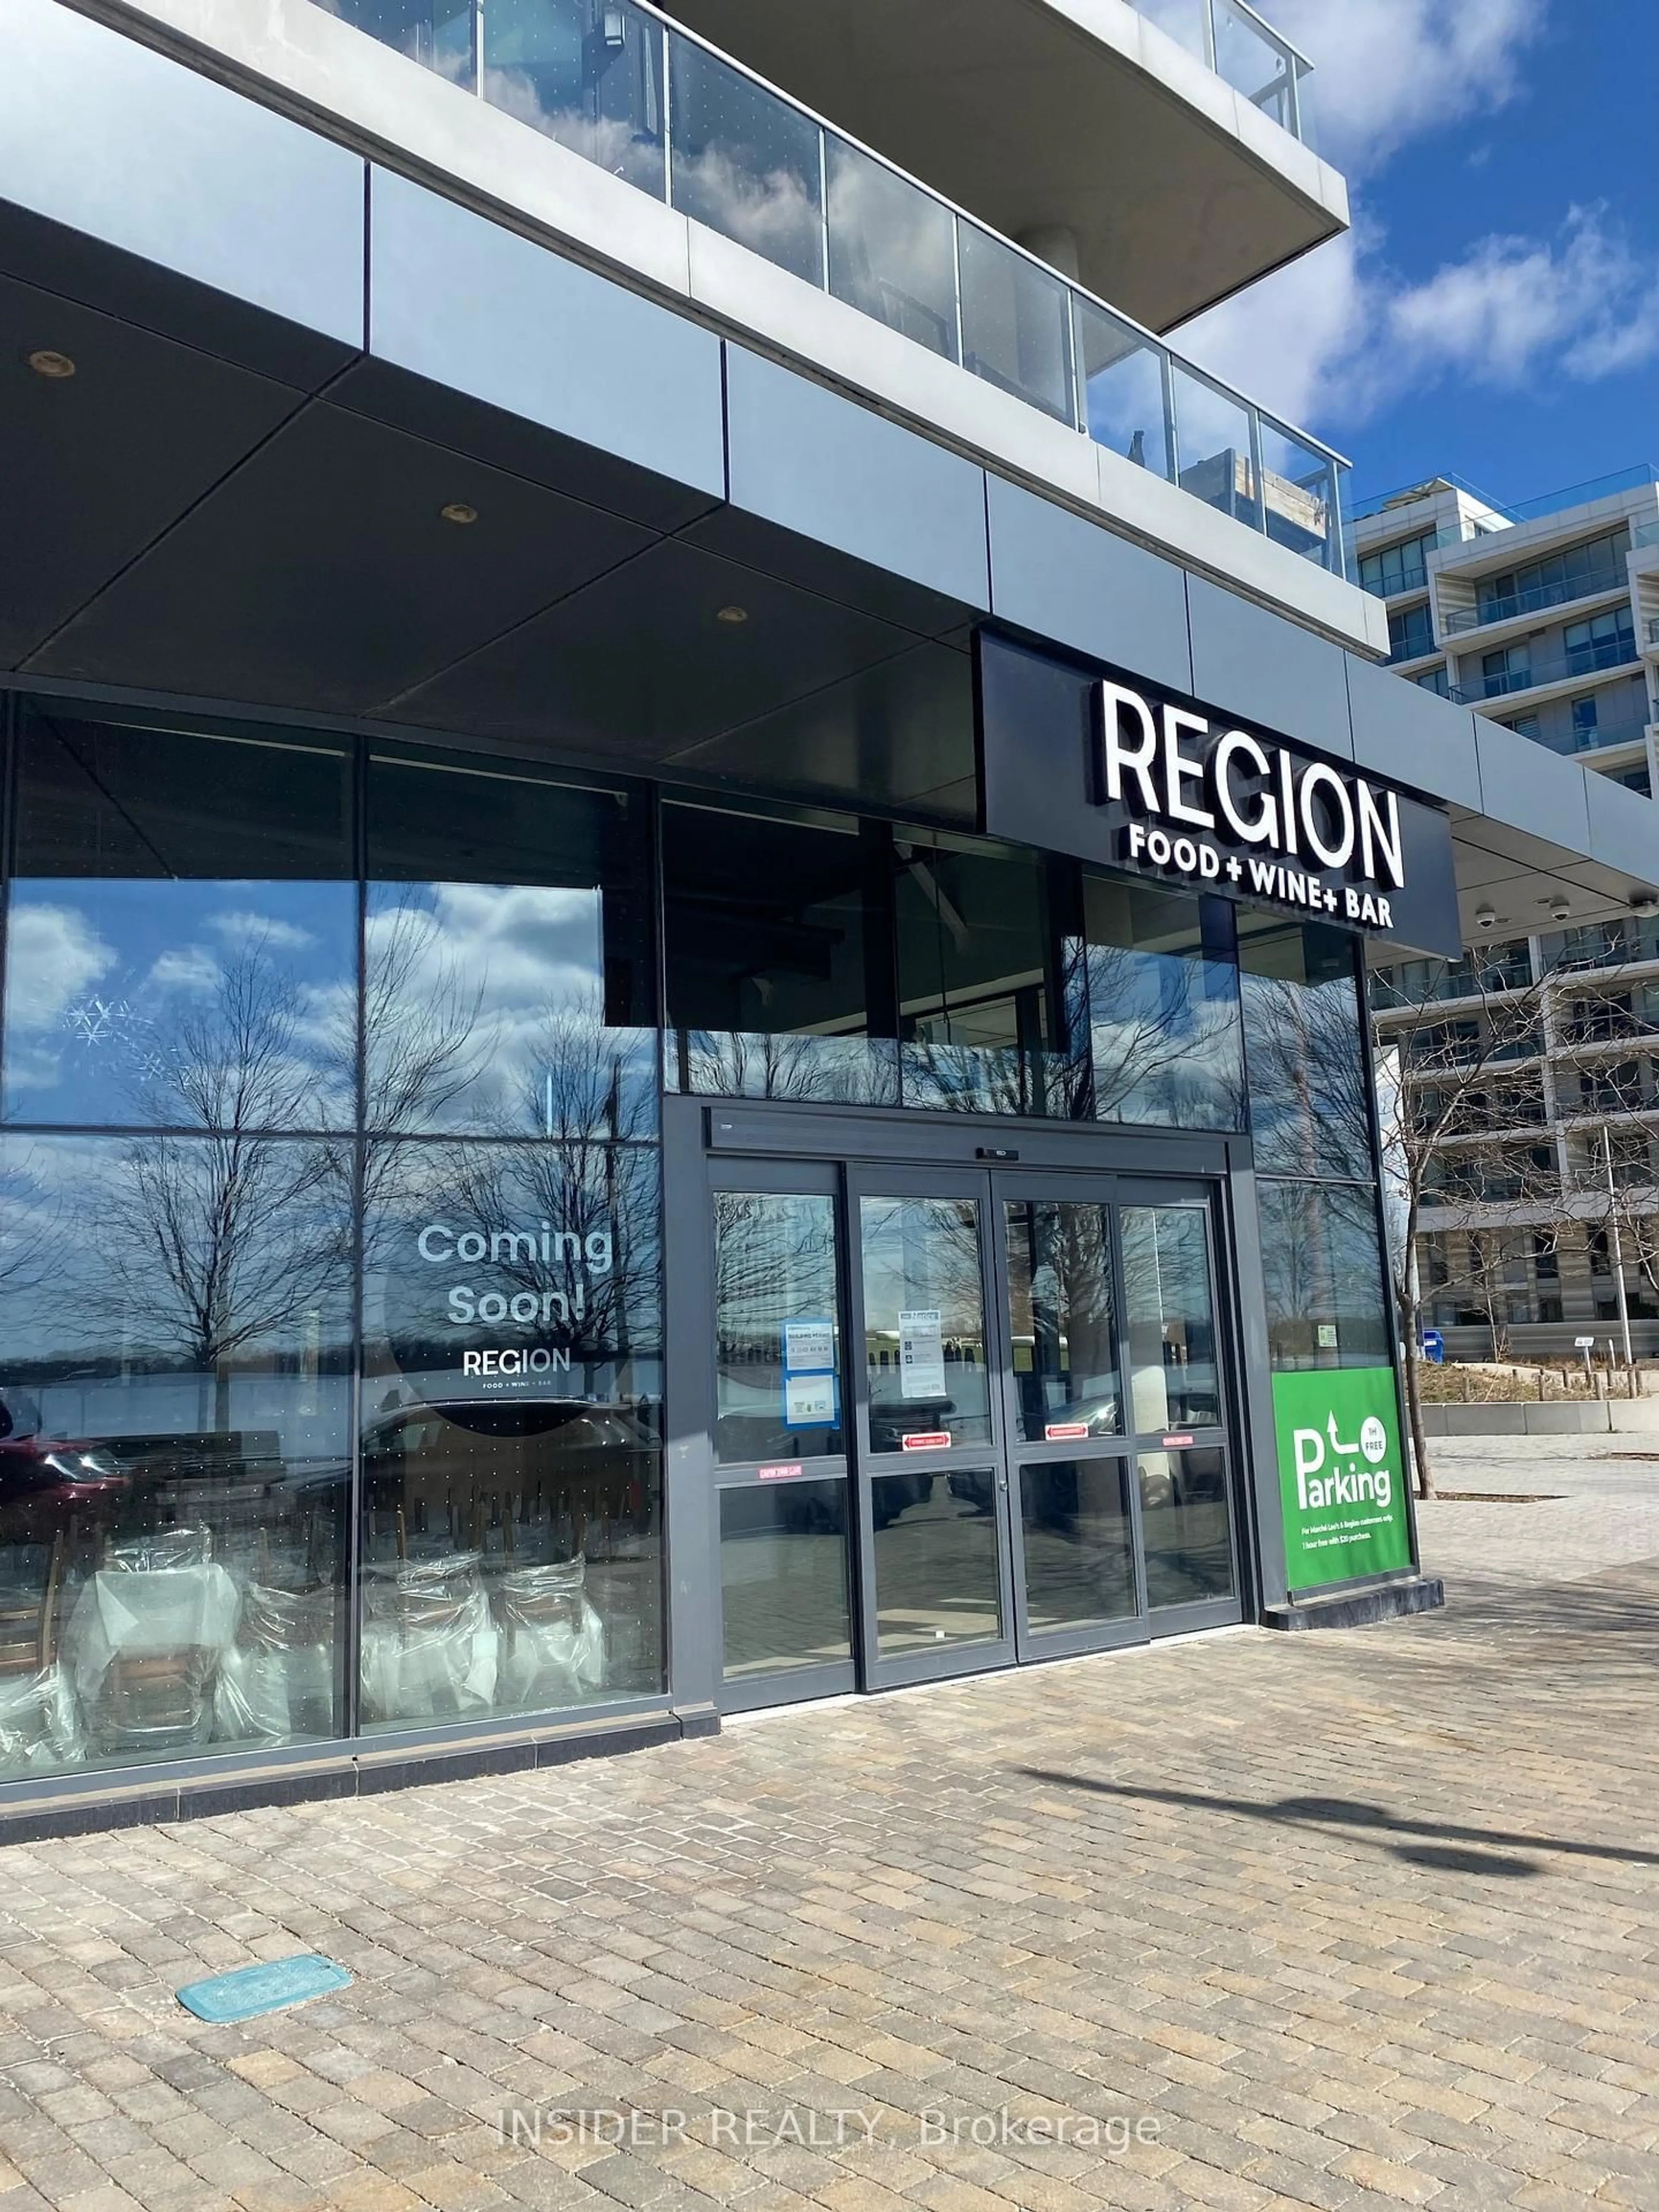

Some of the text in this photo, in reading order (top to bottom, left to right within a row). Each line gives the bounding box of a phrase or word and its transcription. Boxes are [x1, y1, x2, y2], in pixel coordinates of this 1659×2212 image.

[1103, 680, 1404, 889] REGION
[1129, 823, 1220, 878] FOOD
[1346, 887, 1393, 928] BAR
[418, 1221, 613, 1273] Coming
[448, 1284, 585, 1324] Soon!
[463, 1347, 570, 1376] REGION
[1365, 1440, 1383, 1451] FREE
[1368, 1427, 1377, 1436] 1H
[1293, 1428, 1392, 1510] Parking
